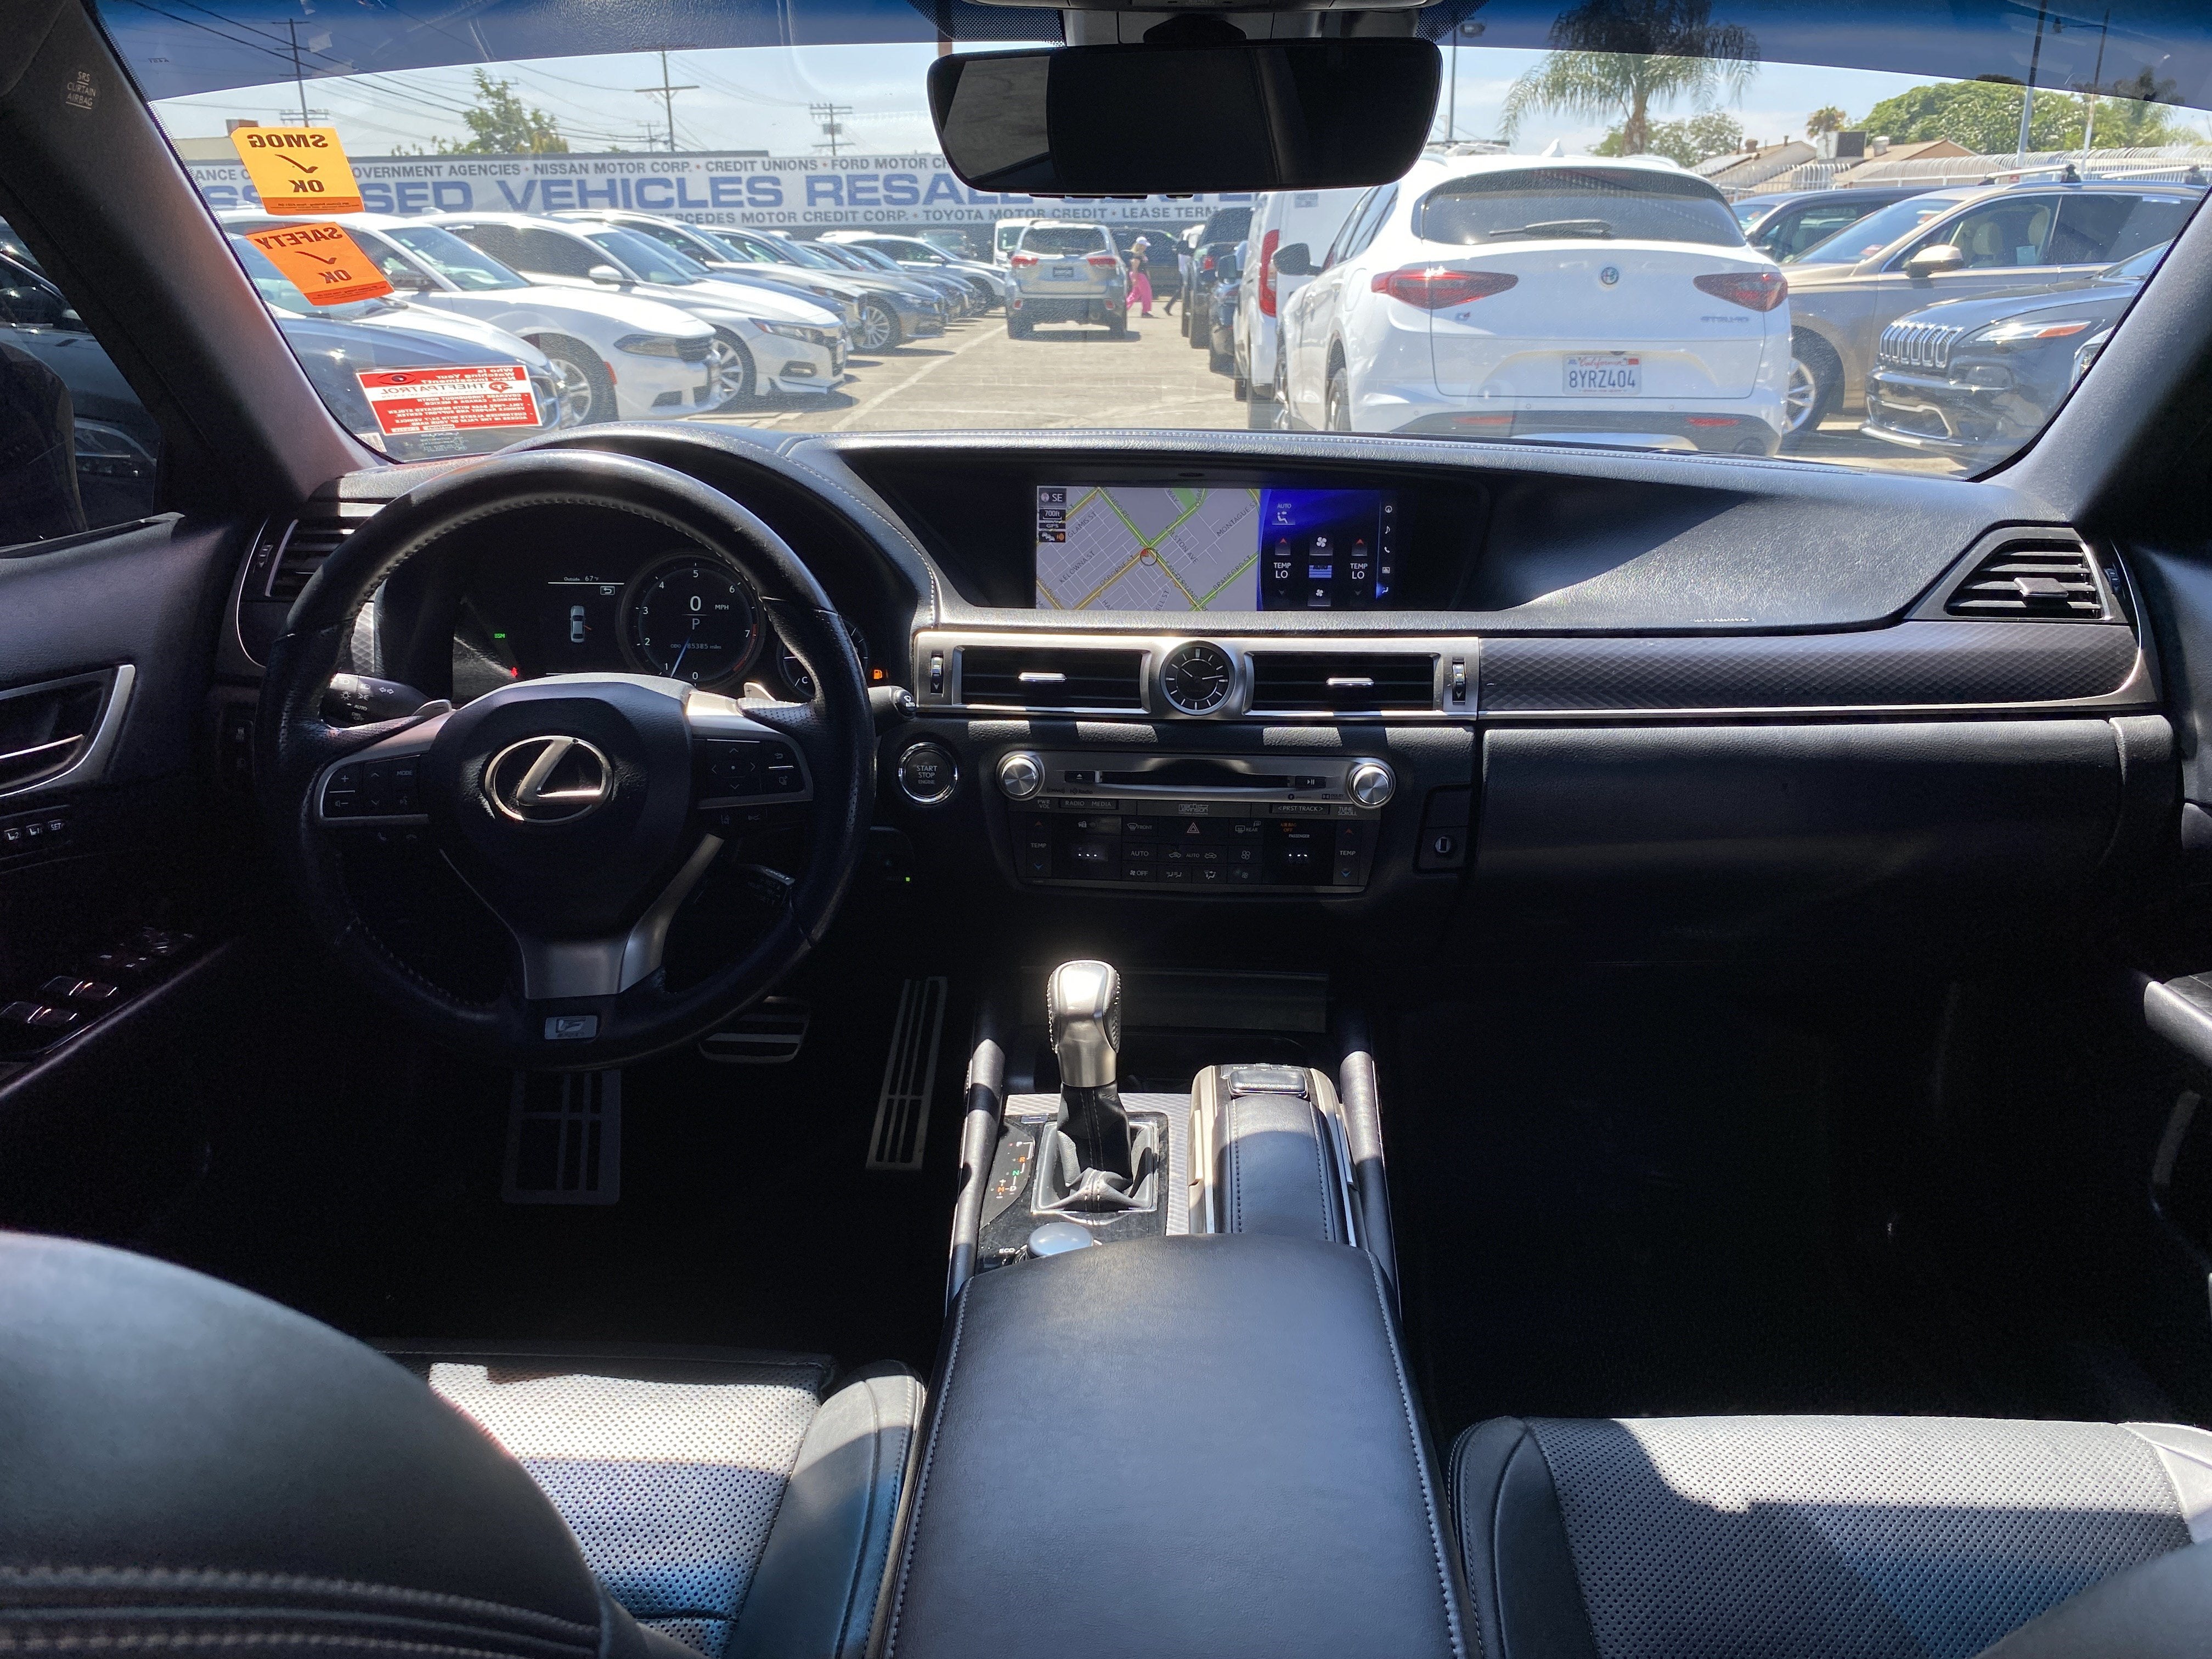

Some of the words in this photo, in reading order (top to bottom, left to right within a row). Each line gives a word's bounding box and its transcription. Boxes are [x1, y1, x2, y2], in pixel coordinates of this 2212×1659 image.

[77, 71, 90, 82] SRS
[67, 82, 96, 97] CURTAIN
[67, 93, 93, 106] AIRBAG
[352, 165, 442, 179] OVERNMENT
[448, 163, 521, 177] AGENCIES
[534, 162, 590, 175] NISSAN
[595, 161, 646, 174] MOTOR
[651, 161, 693, 173] CORP.
[706, 160, 758, 172] CREDIT
[765, 159, 819, 172] UNIONS
[831, 158, 872, 171] FORD
[876, 157, 928, 170] MOTOR
[496, 174, 784, 211] VEHICLES
[741, 211, 797, 223] MOTOR
[803, 210, 852, 223] CREDIT
[863, 210, 909, 222] CORP.
[923, 209, 984, 221] TOYOTA
[989, 208, 1046, 220] MOTOR
[1052, 207, 1107, 219] CREDIT
[1122, 207, 1171, 218] LEASE
[1579, 356, 1623, 369] California
[1569, 370, 1635, 388] 8YRZ404
[1052, 494, 1063, 502] SE
[1167, 488, 1180, 503] WAY
[1068, 519, 1089, 538] GLAMIS
[1088, 511, 1097, 521] ST
[1216, 506, 1251, 537] MONTAGUE
[1187, 552, 1199, 565] AVE
[693, 569, 699, 578] 5
[1059, 557, 1089, 584] KELOWNA
[1087, 550, 1096, 560] ST
[1100, 561, 1127, 586] OSBORNE
[1126, 554, 1136, 563] ST
[1212, 562, 1245, 591] BRANFORD
[1243, 554, 1252, 563] ST
[1275, 570, 1289, 578] LO
[1352, 571, 1365, 579] LO
[690, 595, 702, 611] 0
[692, 618, 700, 630] P
[645, 637, 651, 646] 2
